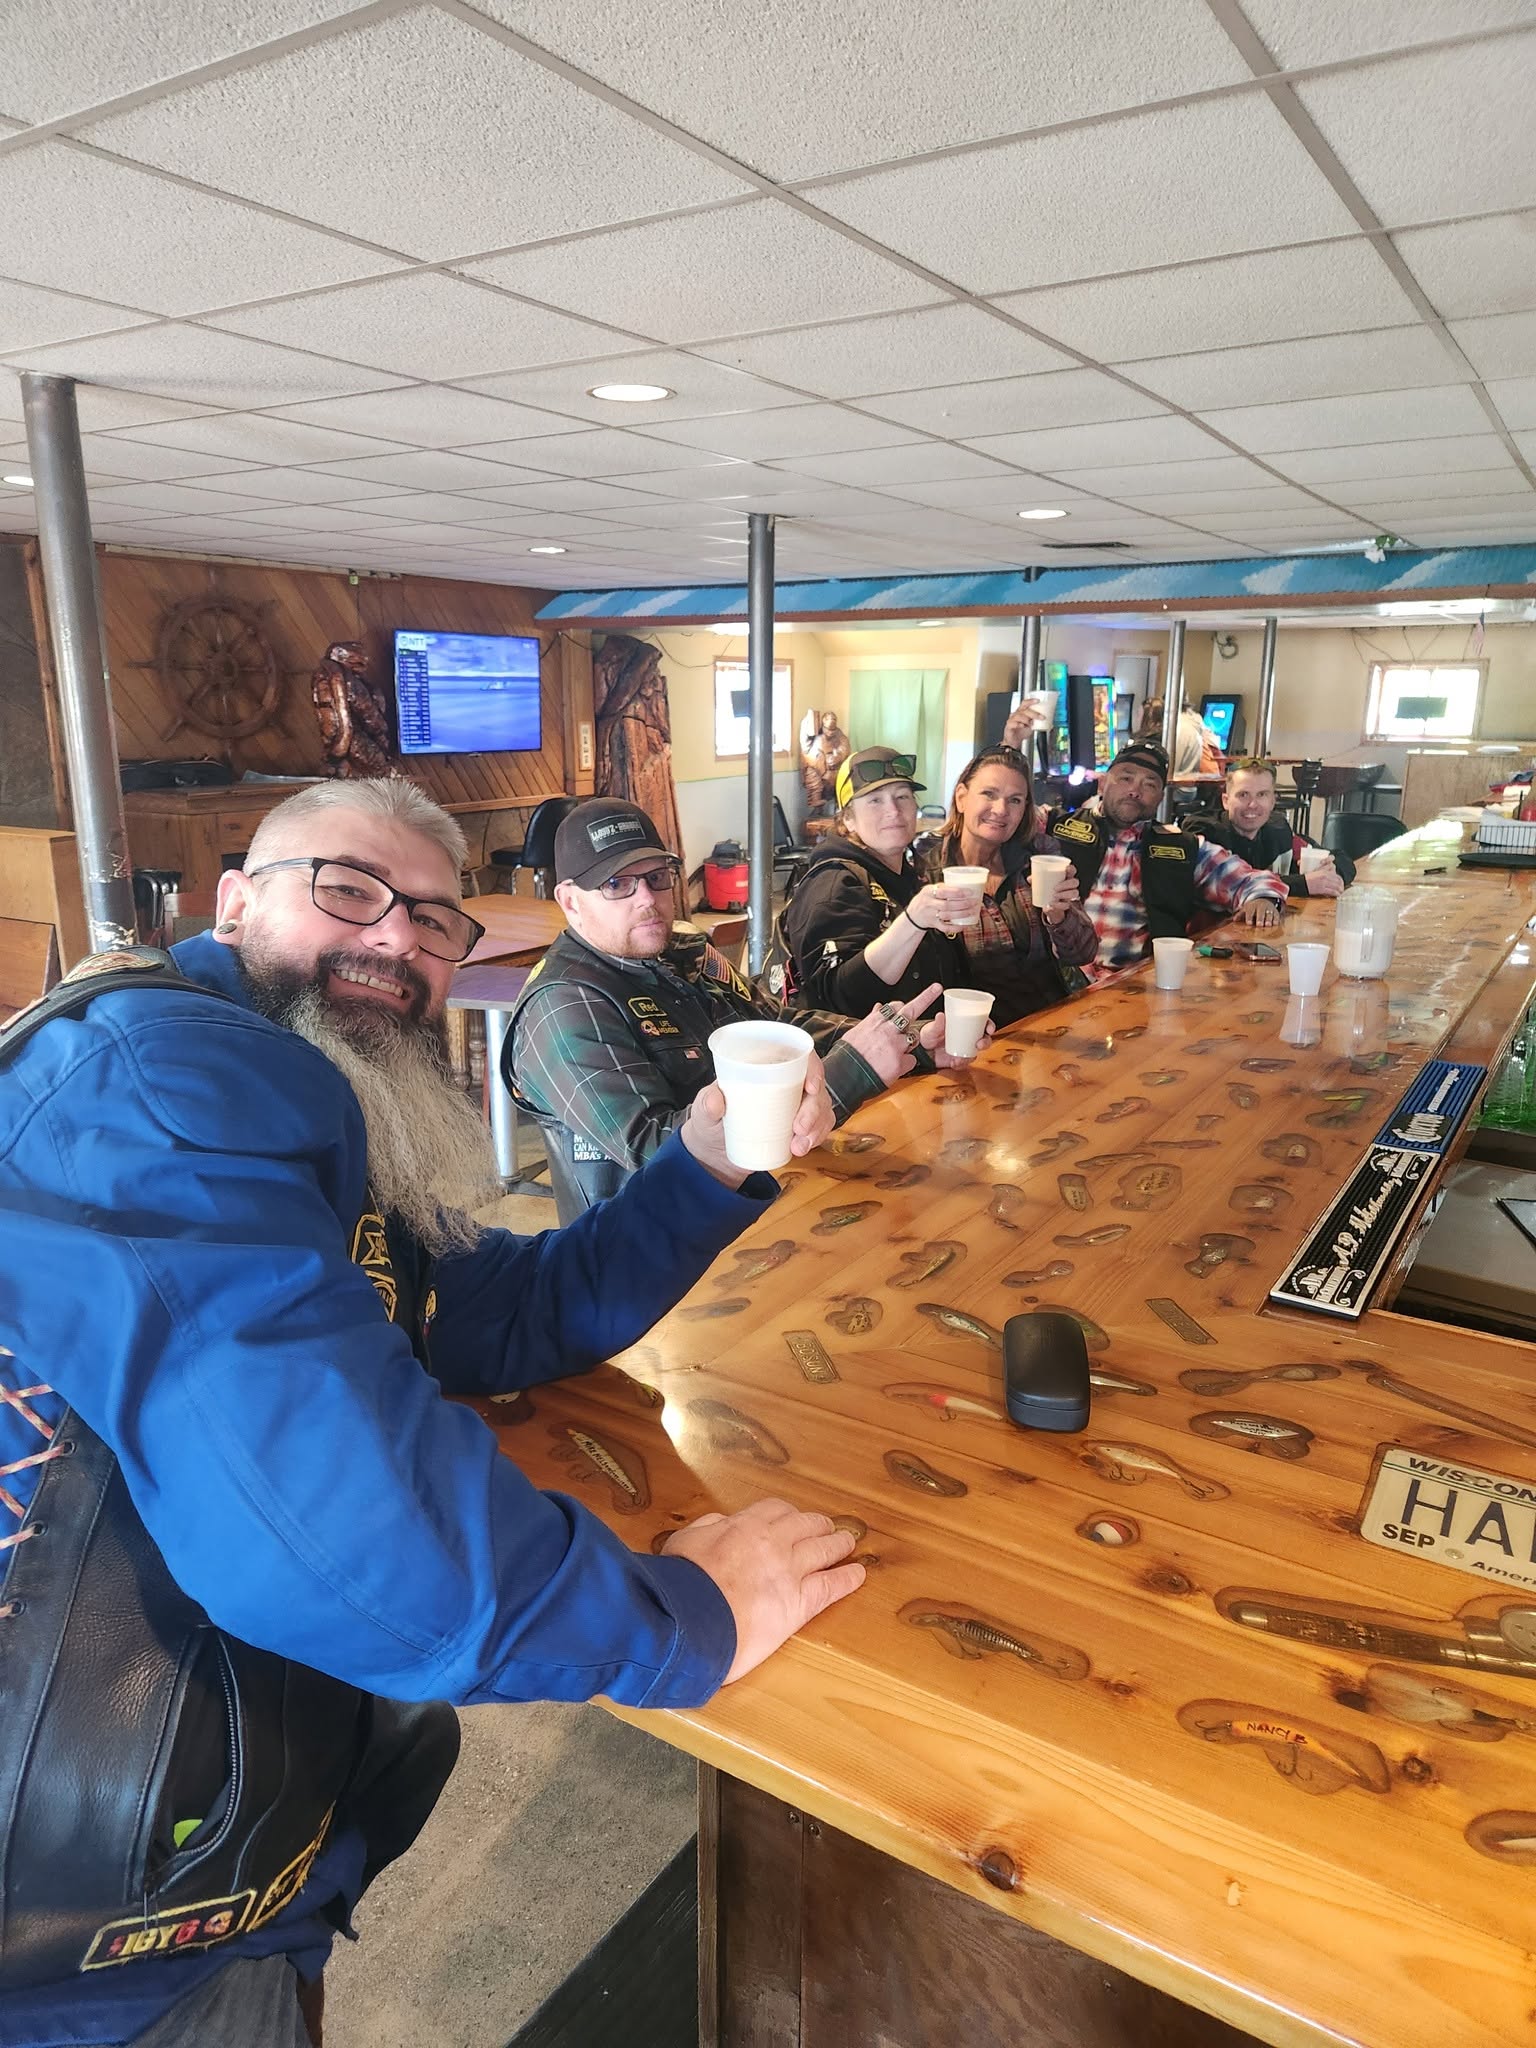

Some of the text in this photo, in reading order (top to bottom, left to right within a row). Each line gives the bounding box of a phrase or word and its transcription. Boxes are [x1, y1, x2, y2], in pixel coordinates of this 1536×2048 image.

[638, 1002, 660, 1013] Red
[573, 1143, 587, 1152] CAN
[574, 1151, 602, 1161] MBA's
[1382, 1523, 1435, 1548] SEP
